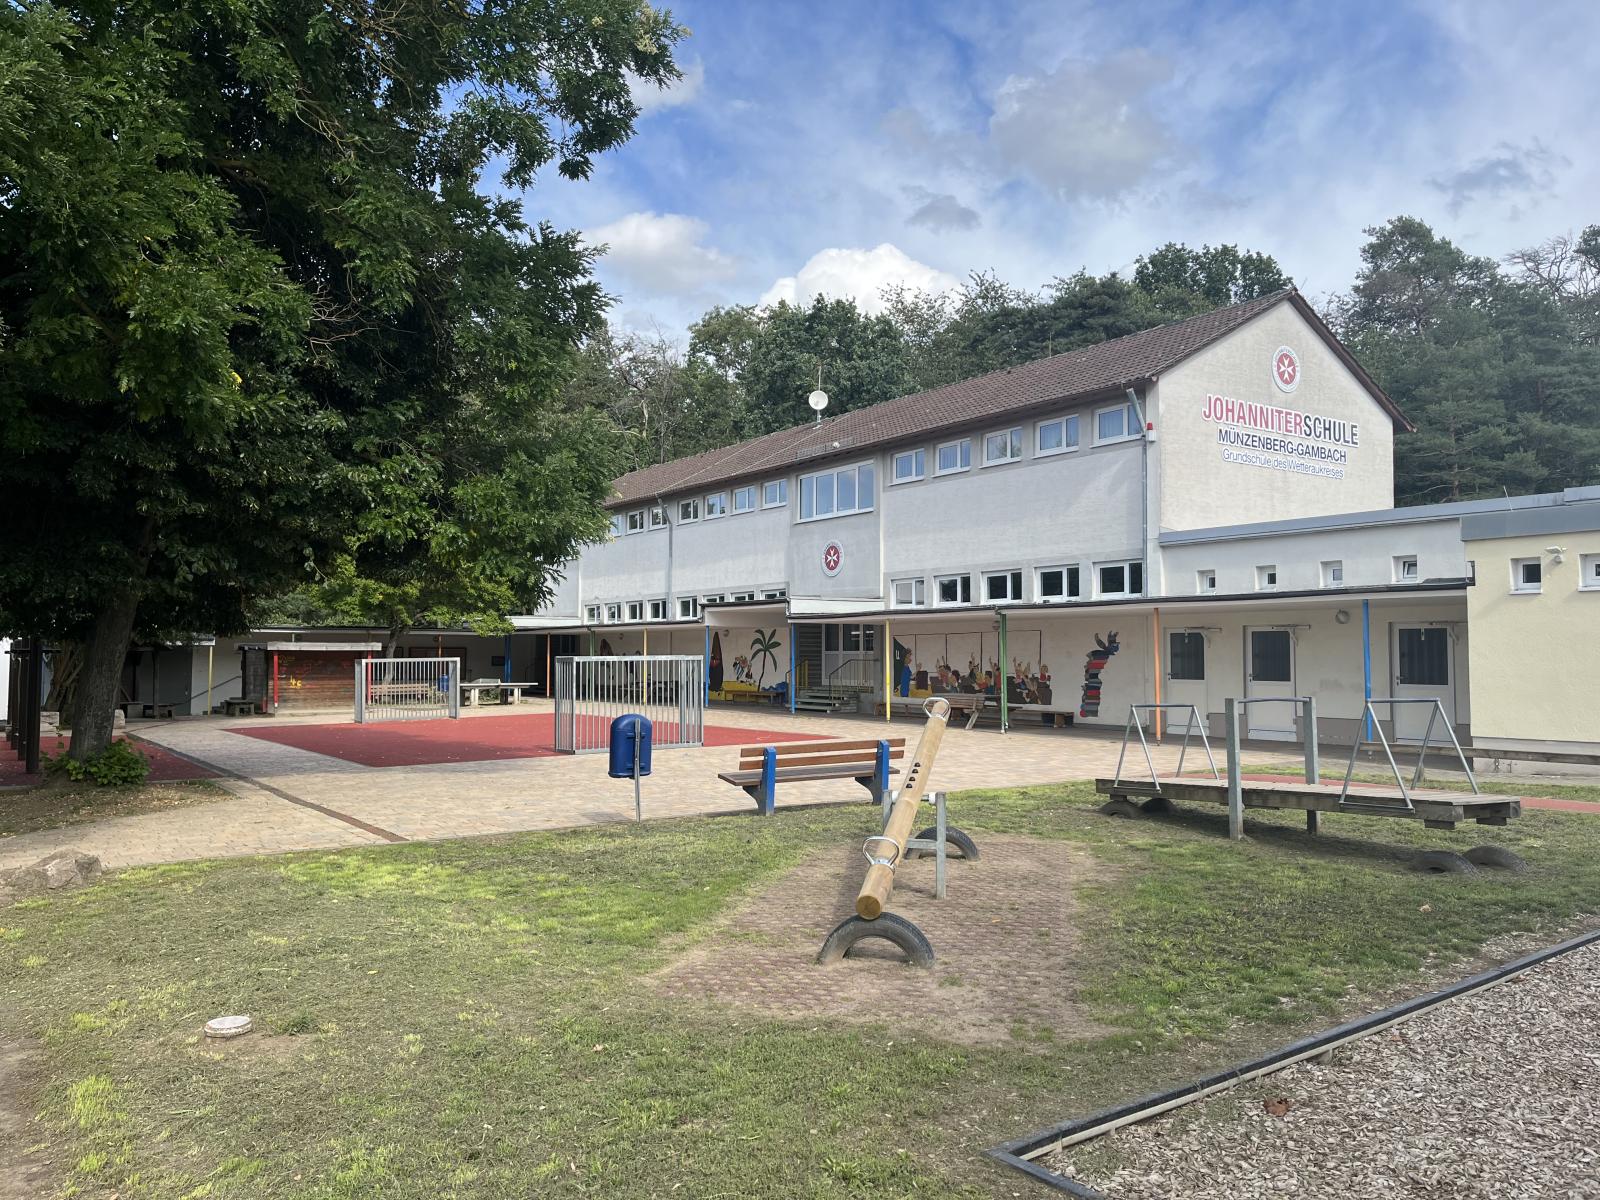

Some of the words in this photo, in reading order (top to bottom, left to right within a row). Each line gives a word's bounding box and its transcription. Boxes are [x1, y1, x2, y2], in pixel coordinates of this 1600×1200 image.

[1203, 395, 1359, 446] JOHANNITERSCHULE
[1218, 427, 1347, 463] MÜNZENBERG-GAMBACH
[1222, 448, 1272, 467] Grundschule
[1273, 458, 1287, 469] des
[1287, 460, 1344, 479] Wetteraukreises
